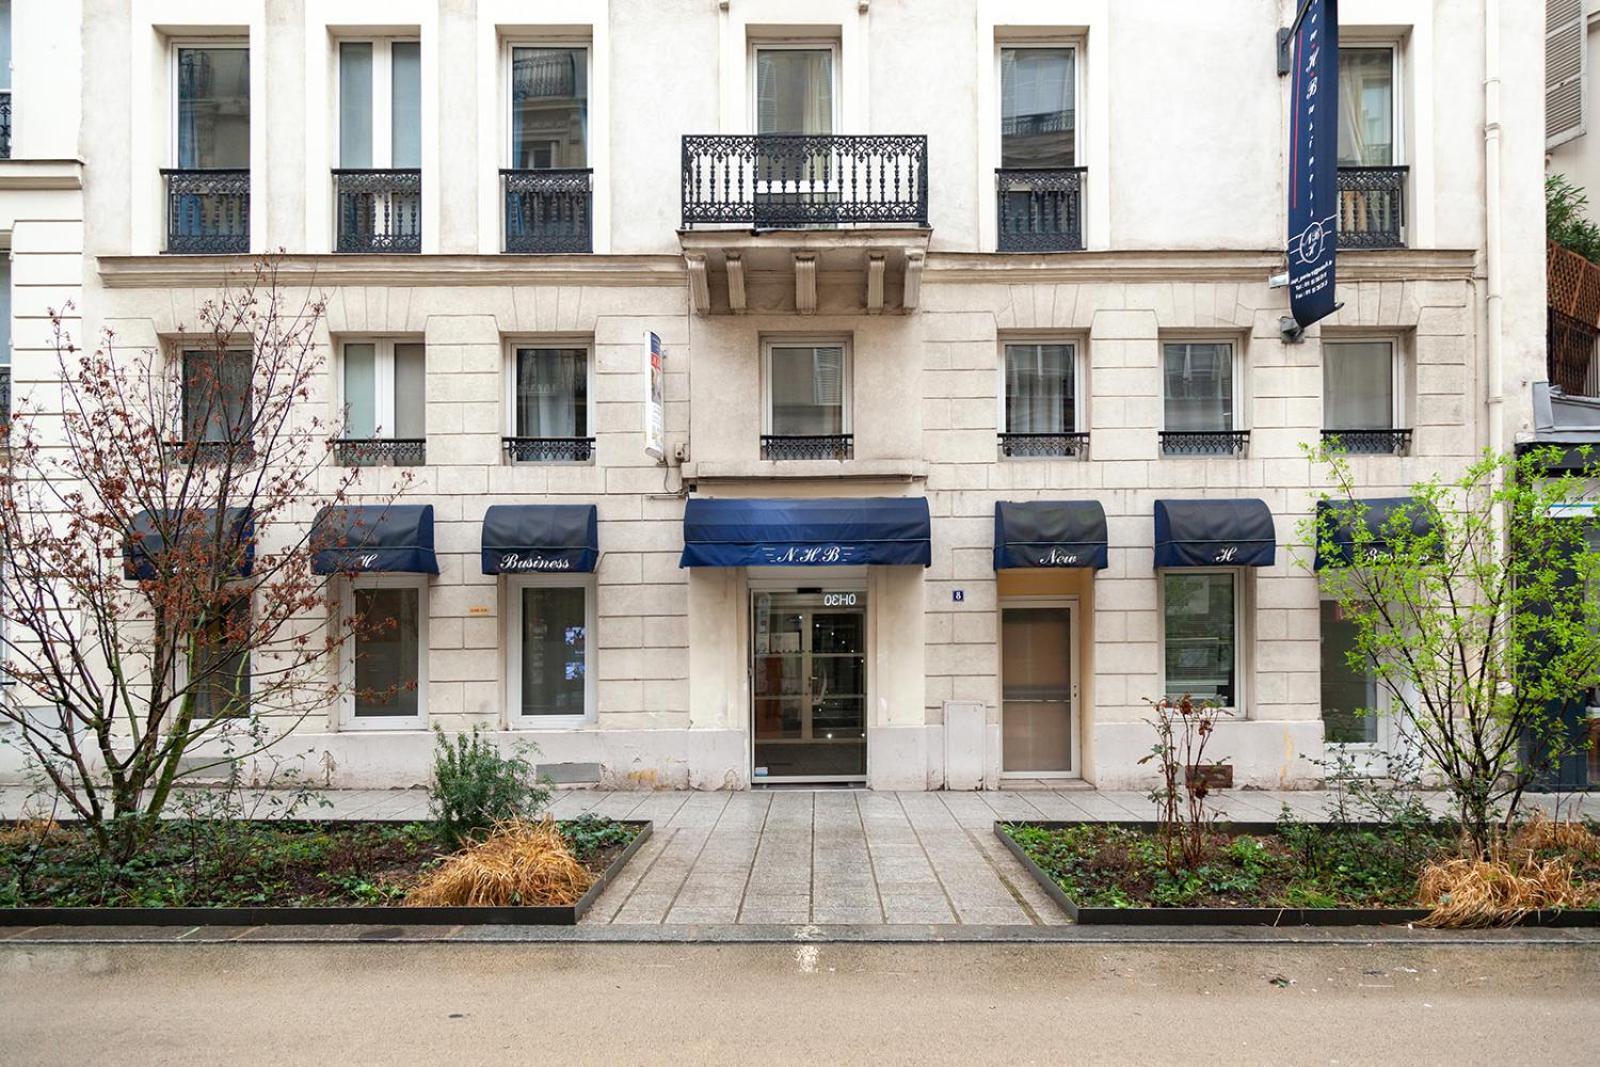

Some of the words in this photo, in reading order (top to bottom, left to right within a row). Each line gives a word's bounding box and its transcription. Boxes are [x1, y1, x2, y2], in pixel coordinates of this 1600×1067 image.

[500, 553, 570, 569] Business
[1040, 549, 1077, 564] New
[1215, 547, 1237, 562] H
